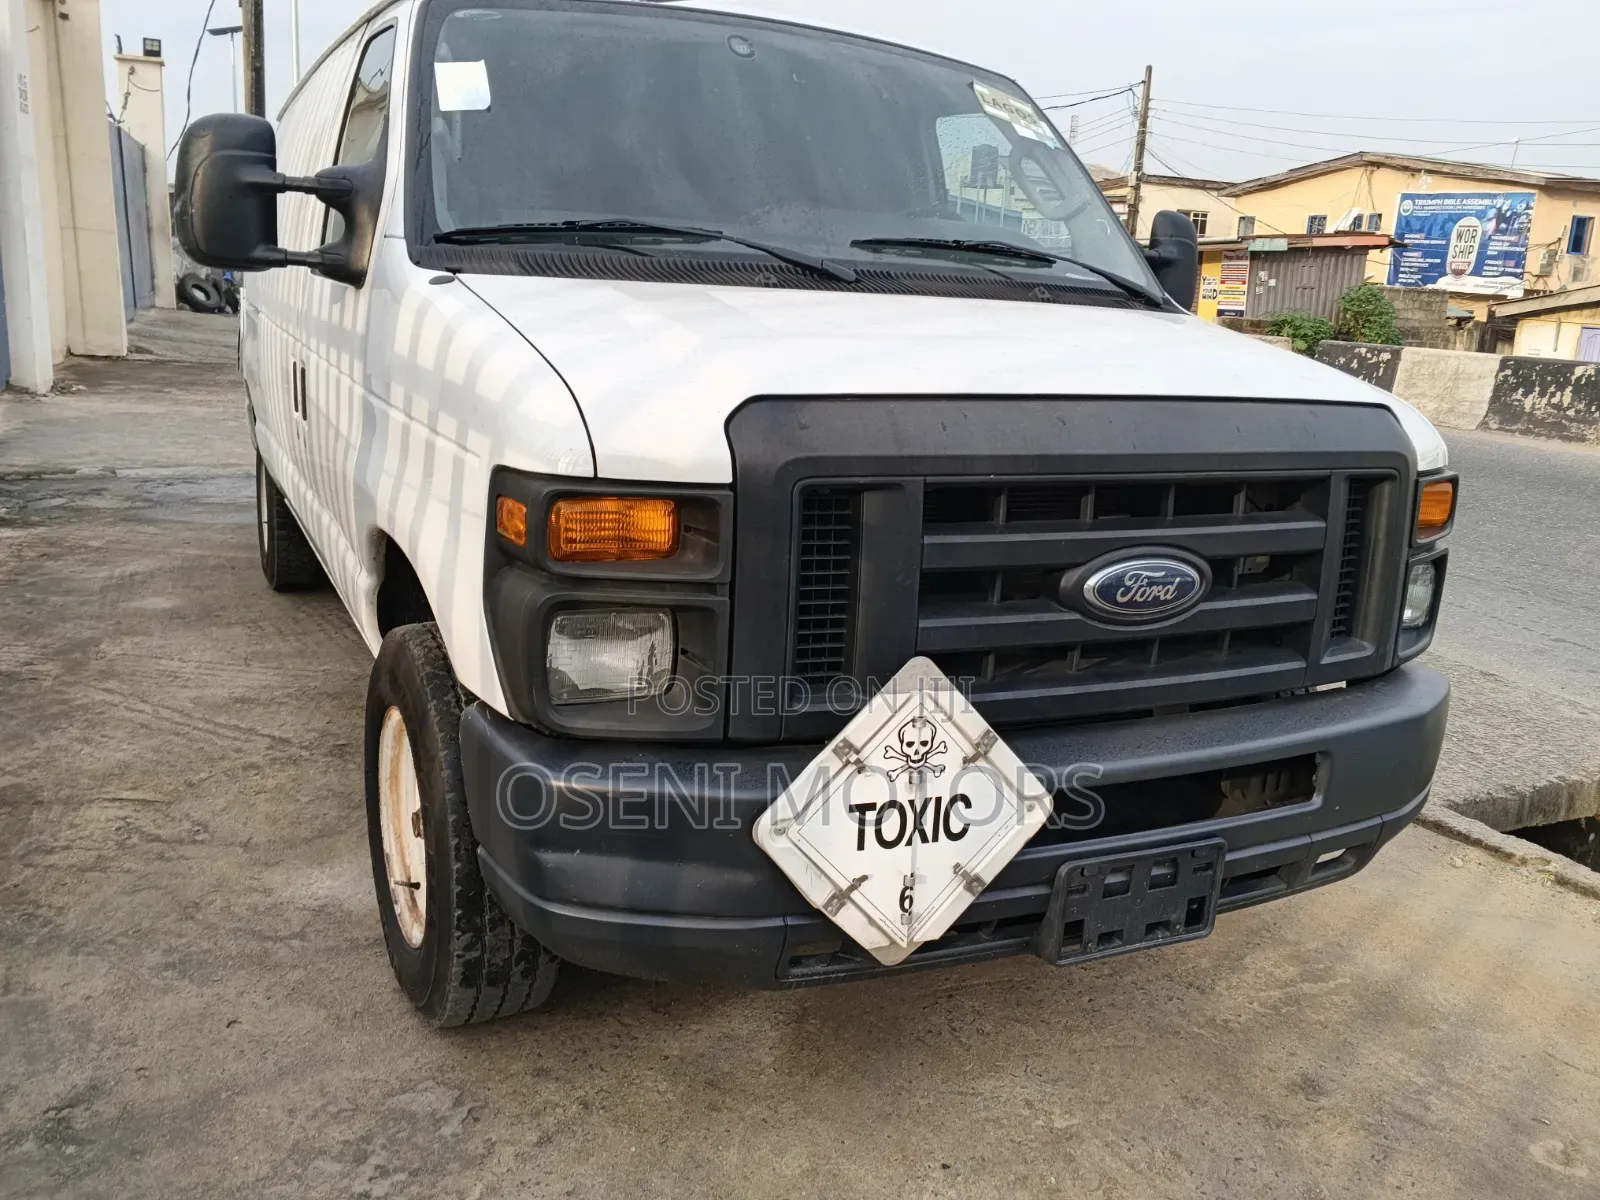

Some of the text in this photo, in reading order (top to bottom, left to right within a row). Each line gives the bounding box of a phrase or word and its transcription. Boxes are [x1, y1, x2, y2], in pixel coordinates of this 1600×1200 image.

[979, 92, 1038, 125] LAGOS
[1461, 198, 1498, 206] ASSEMBLY
[1456, 229, 1478, 244] WOR
[1452, 244, 1475, 260] SHIP
[1116, 570, 1181, 603] Ford
[848, 792, 973, 852] TOXIC
[898, 885, 914, 914] 6
